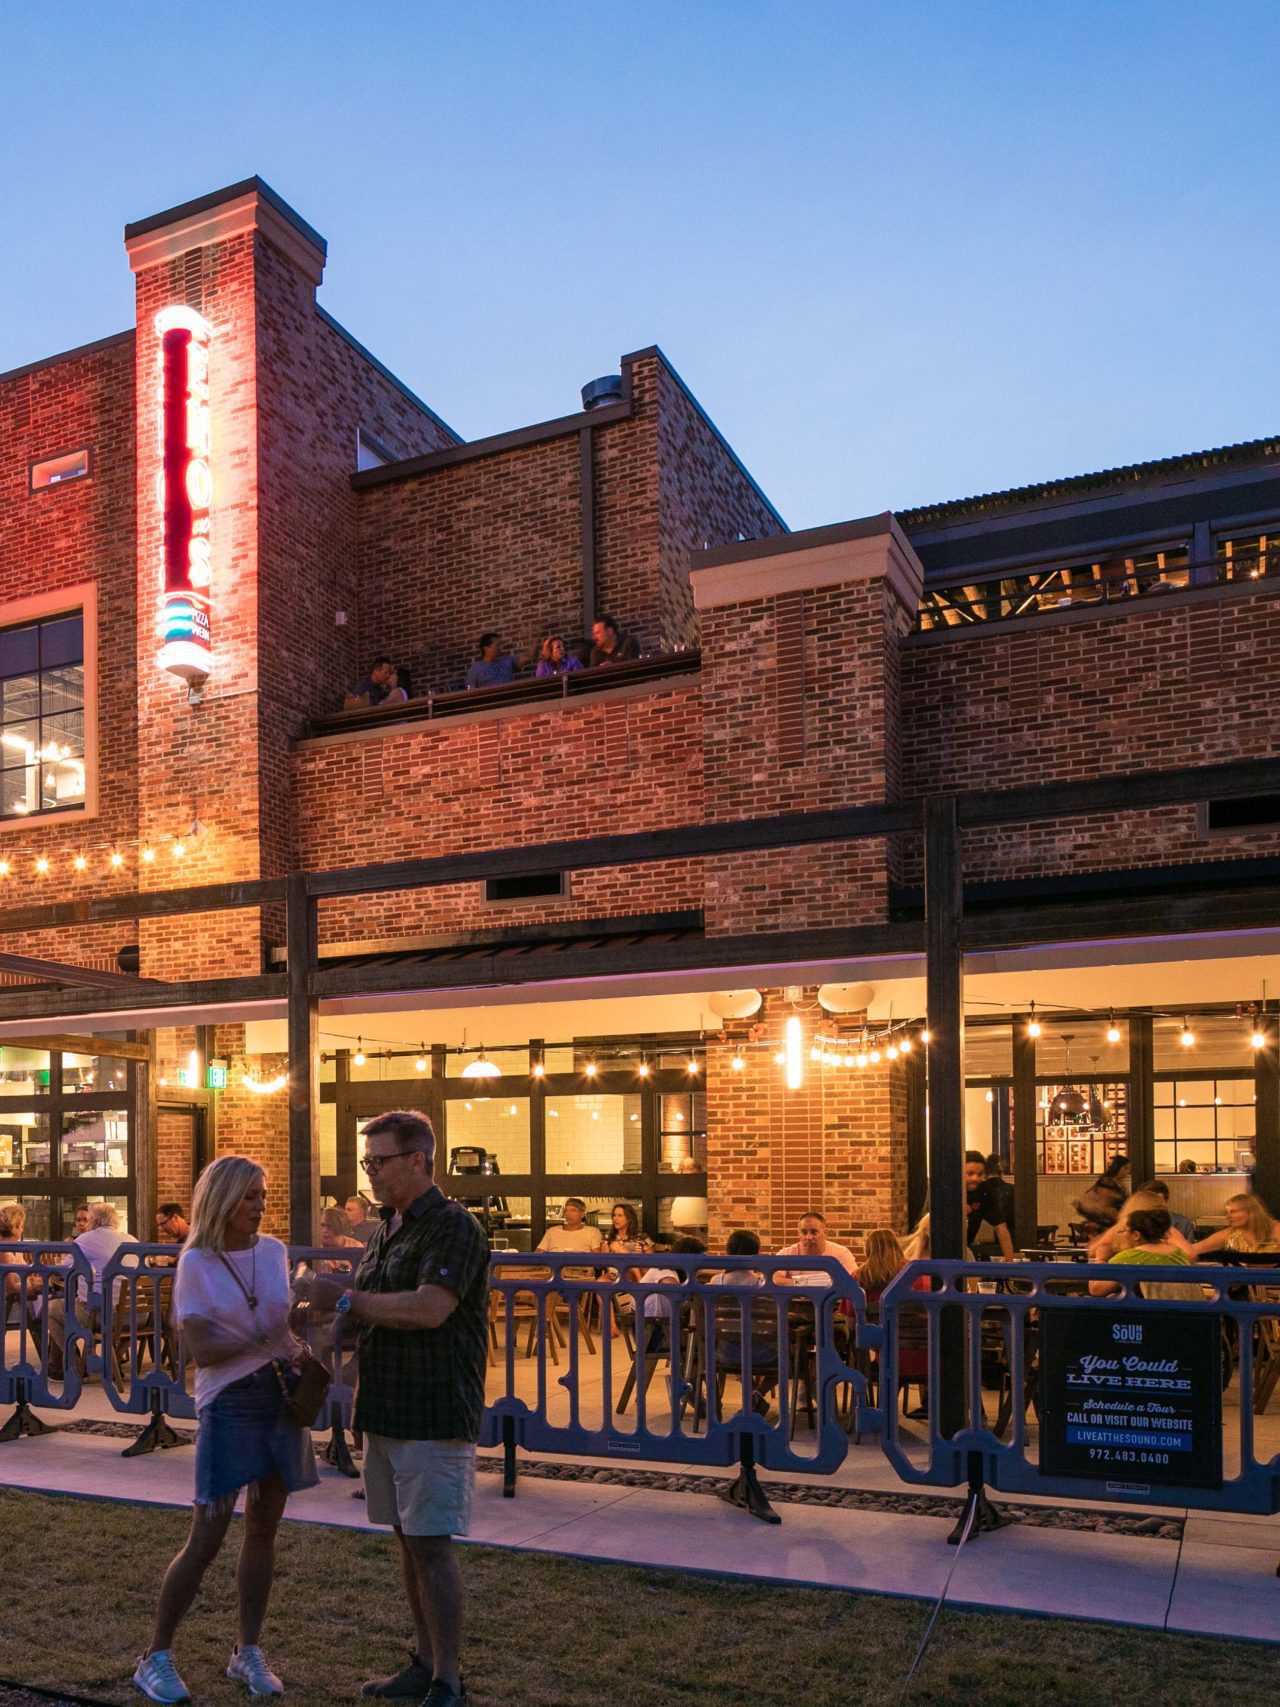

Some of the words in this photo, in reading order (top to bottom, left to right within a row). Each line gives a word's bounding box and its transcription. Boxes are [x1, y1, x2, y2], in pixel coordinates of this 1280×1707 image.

[1080, 1354, 1120, 1374] You
[1122, 1356, 1179, 1373] Could
[1066, 1373, 1122, 1386] LIVE
[1124, 1377, 1191, 1390] HERE
[1083, 1399, 1136, 1412] Schedule
[1136, 1404, 1146, 1412] a
[1146, 1402, 1176, 1414] Tour
[1067, 1412, 1089, 1424] CALL
[1090, 1414, 1103, 1425] OR
[1104, 1414, 1129, 1427] VISIT
[1130, 1416, 1149, 1428] OUR
[1151, 1417, 1193, 1431] WEBSITE
[1077, 1430, 1182, 1448] LIVEATTHESOUND.COM
[1089, 1448, 1170, 1465] 972.483.0400
